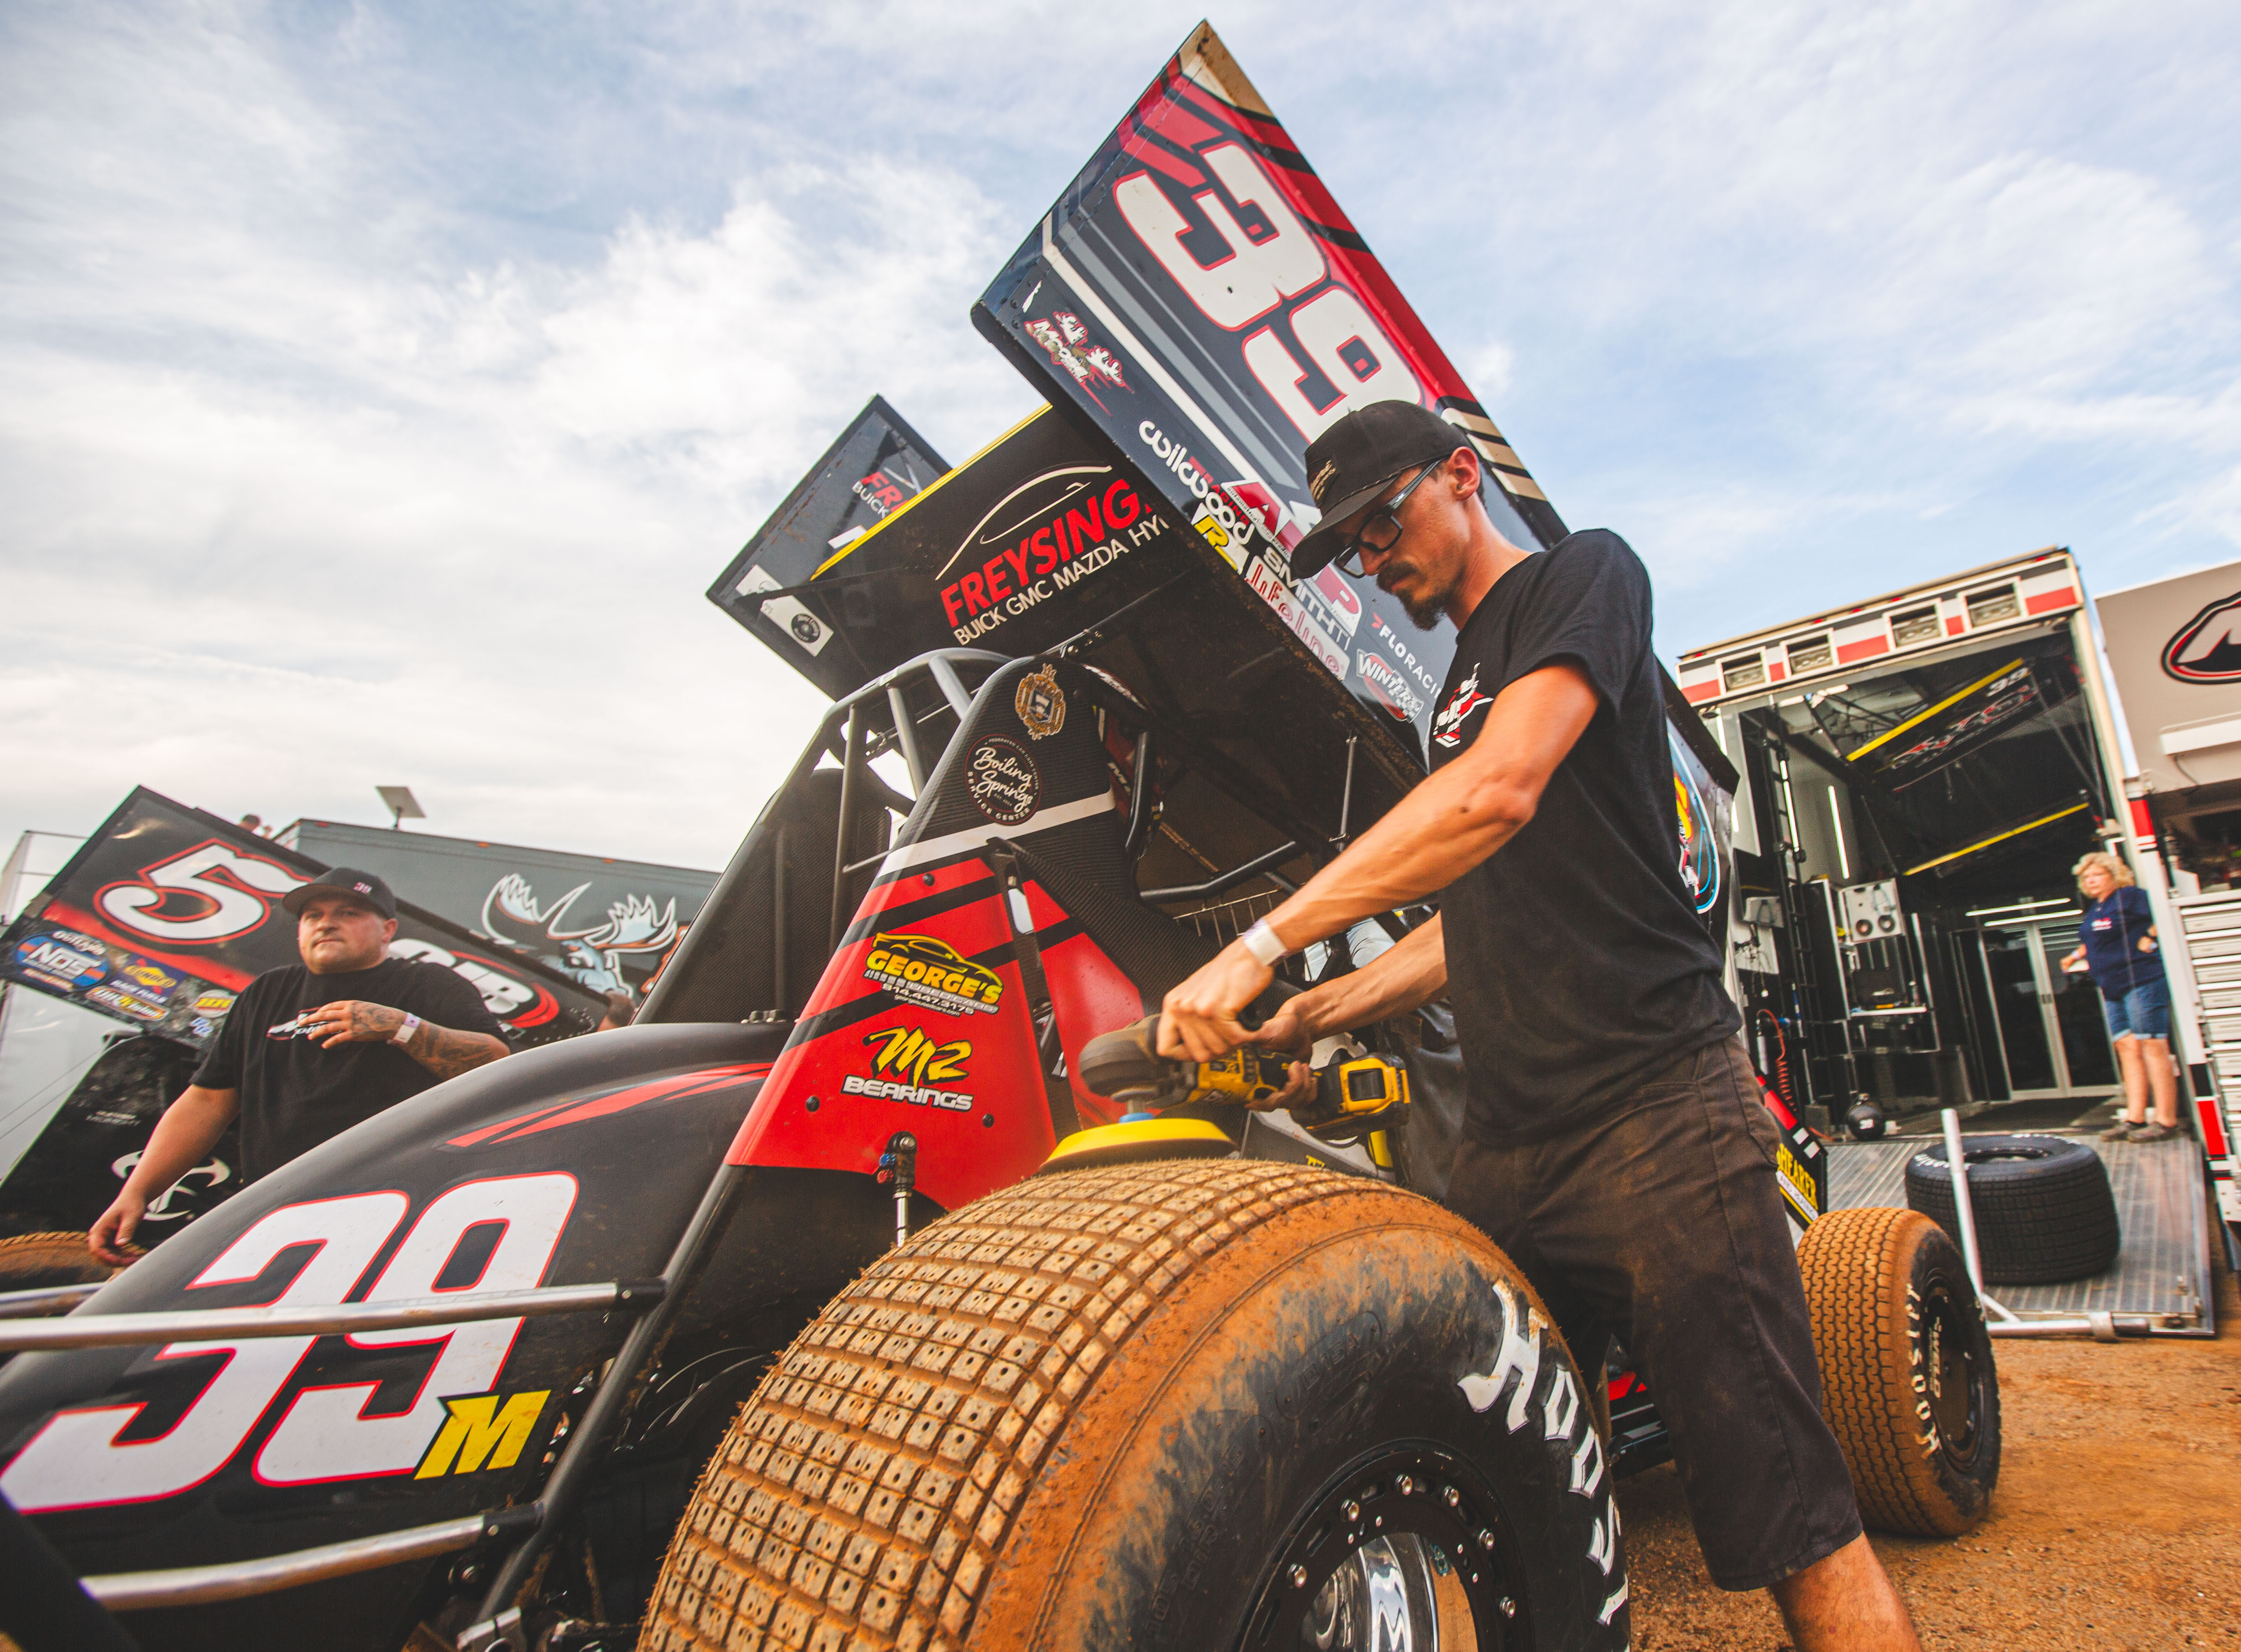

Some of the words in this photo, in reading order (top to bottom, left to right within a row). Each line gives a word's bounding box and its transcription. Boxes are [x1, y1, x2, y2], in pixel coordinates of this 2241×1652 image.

[1112, 141, 1423, 445] 39
[852, 480, 889, 519] BUICK
[1139, 420, 1255, 546] wilwood
[940, 479, 1153, 628] FREYSING
[954, 606, 1008, 646] BUICK
[1006, 580, 1053, 616] GMC
[1052, 538, 1129, 590] MAZDA
[967, 771, 993, 815] SERVICE
[995, 807, 1030, 821] CENTER
[973, 746, 1033, 793] Boiling
[976, 770, 1034, 813] Springs
[26, 941, 103, 978] NOS
[866, 949, 1003, 1004] GEORGE'S
[842, 1076, 973, 1111] BEARINGS
[0, 1171, 580, 1515] 39
[413, 1389, 552, 1481] M
